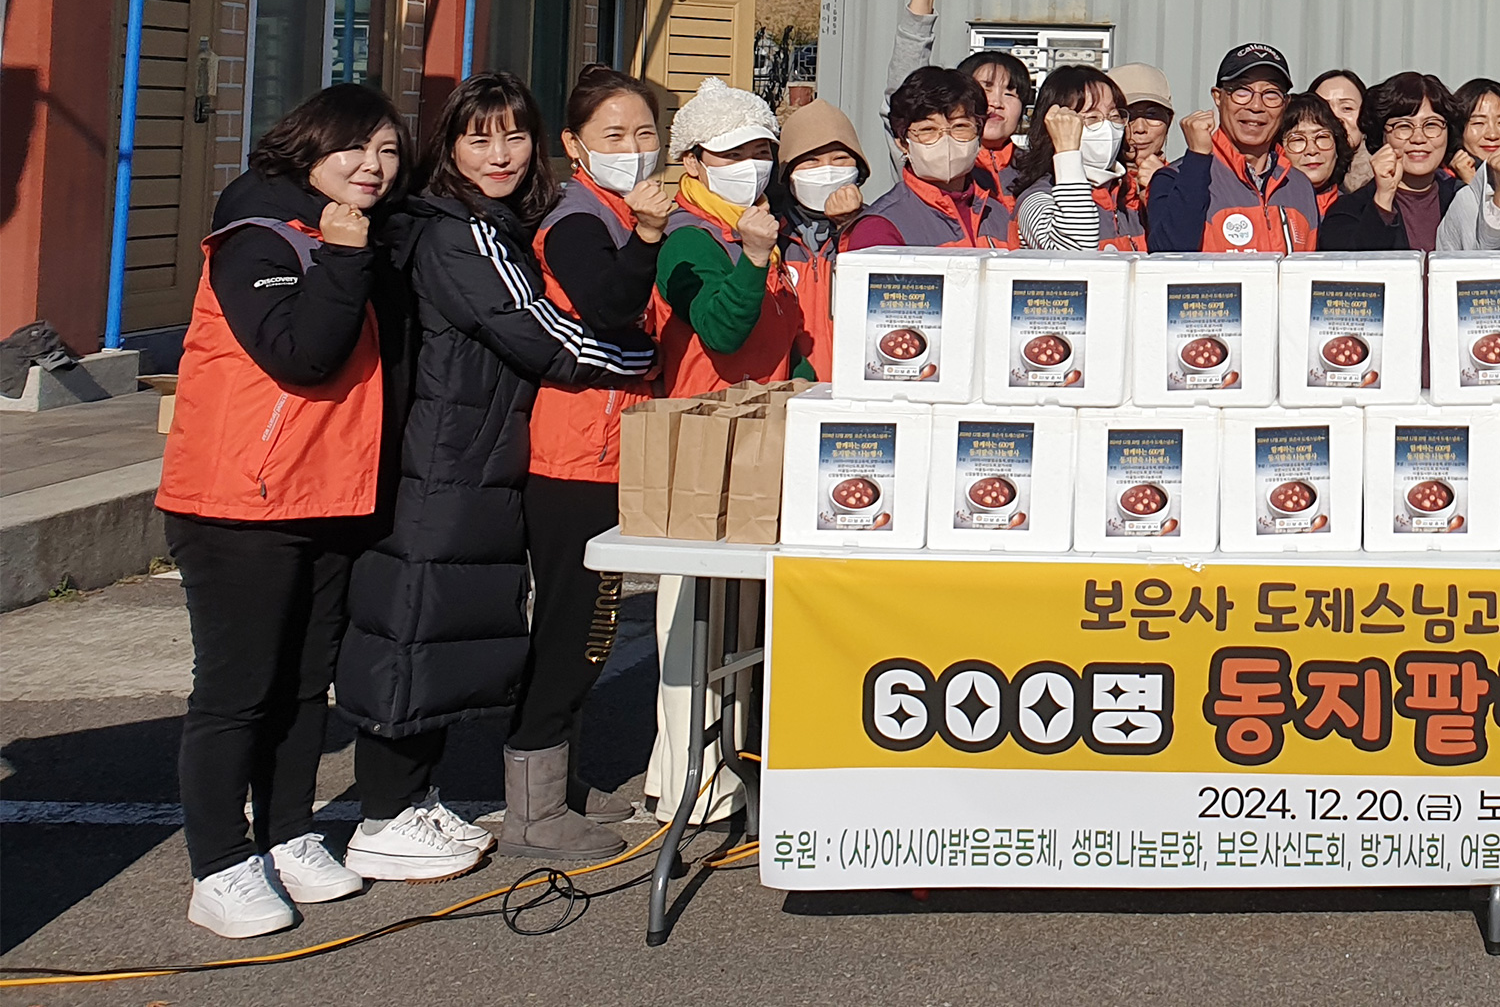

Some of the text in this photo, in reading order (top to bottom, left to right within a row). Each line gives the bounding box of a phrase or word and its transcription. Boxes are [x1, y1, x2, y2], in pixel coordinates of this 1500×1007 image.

[1080, 577, 1234, 641] 보은사
[866, 660, 1170, 751] 600명
[773, 830, 818, 871] 후원
[838, 827, 1063, 871] (사)아시아밝음공동체,
[1071, 830, 1208, 871] 생명나눔문화,
[1216, 832, 1352, 872] 보은사신도회,
[1360, 833, 1453, 873] 방거사회,
